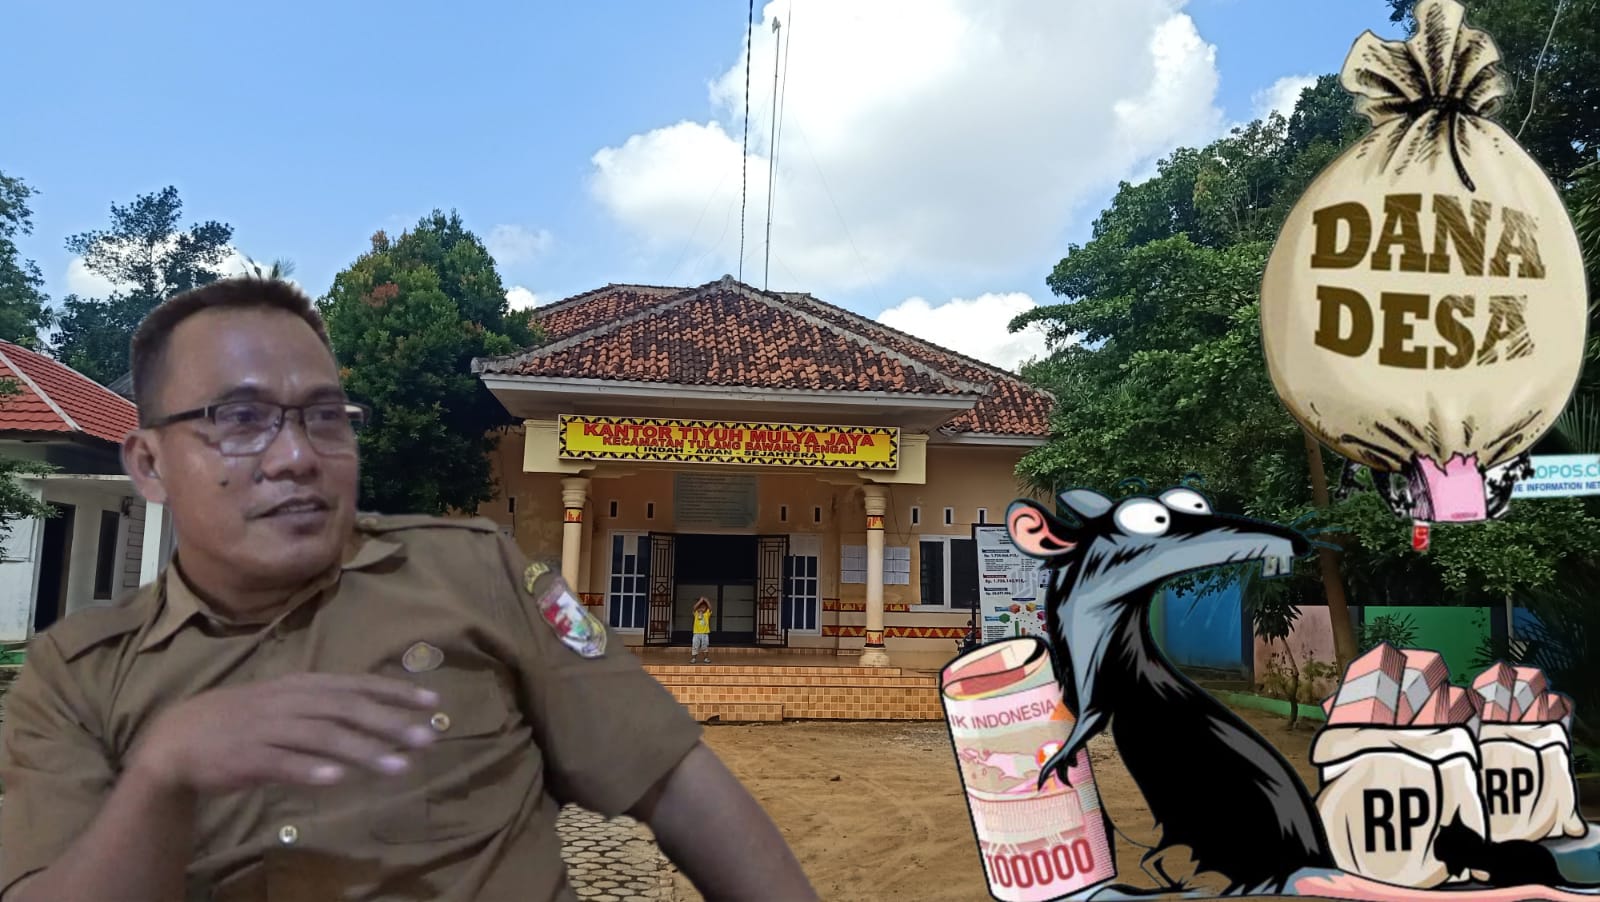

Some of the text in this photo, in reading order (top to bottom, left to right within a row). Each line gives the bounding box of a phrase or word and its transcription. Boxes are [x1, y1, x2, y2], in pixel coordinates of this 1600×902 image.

[584, 423, 875, 447] KANTOR TIYUH MULYA JAYA
[603, 436, 857, 455] KECAMATAN TULANG BAWANG TENGAH
[744, 450, 818, 459] SEJAHTERA
